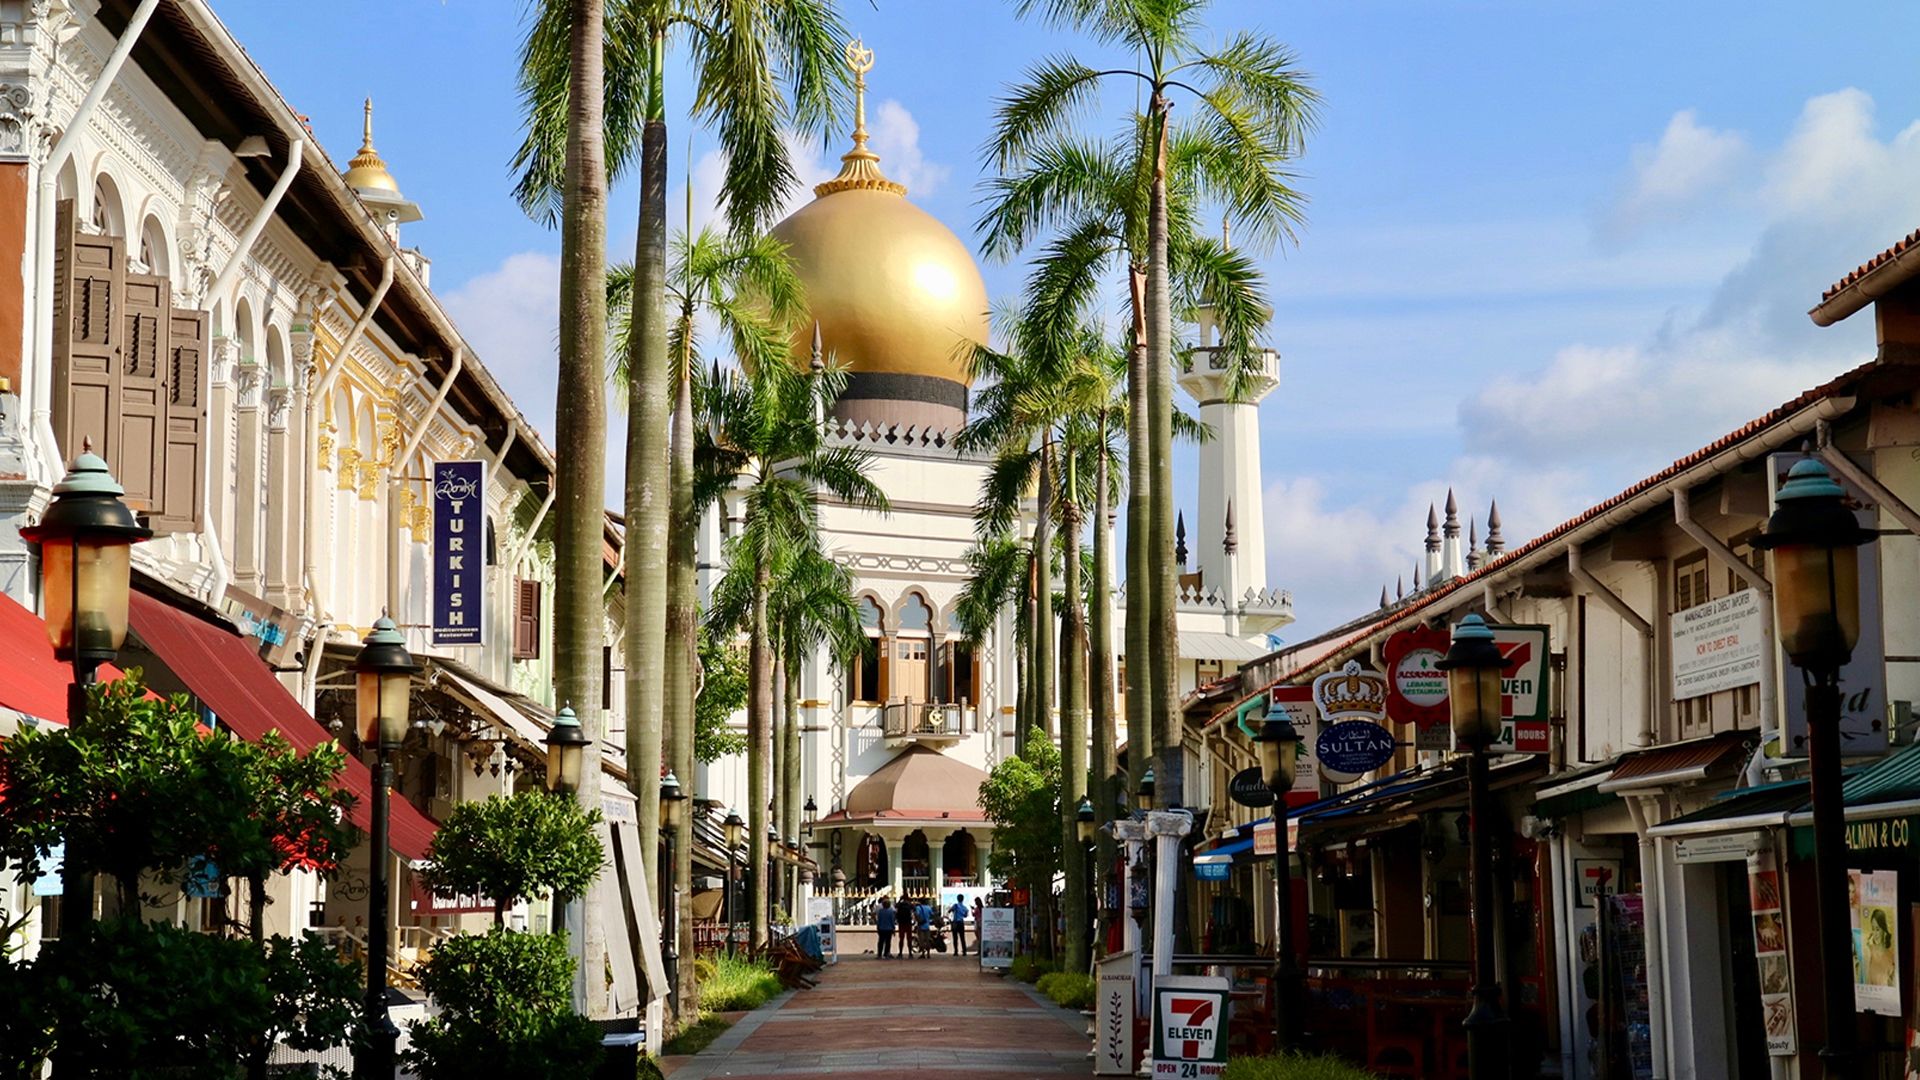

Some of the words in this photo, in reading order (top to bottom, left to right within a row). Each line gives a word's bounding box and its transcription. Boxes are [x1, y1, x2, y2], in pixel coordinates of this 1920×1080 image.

[449, 501, 464, 625] TURKISH
[1517, 730, 1546, 740] HOURS
[1319, 739, 1392, 755] SULTAN
[1880, 821, 1888, 847] &
[1892, 818, 1909, 847] CO
[1171, 998, 1213, 1058] 7
[1768, 1040, 1789, 1050] Beauty
[1156, 1063, 1177, 1073] OPEN
[1181, 1062, 1198, 1078] 24
[1200, 1064, 1227, 1075] HOURS
